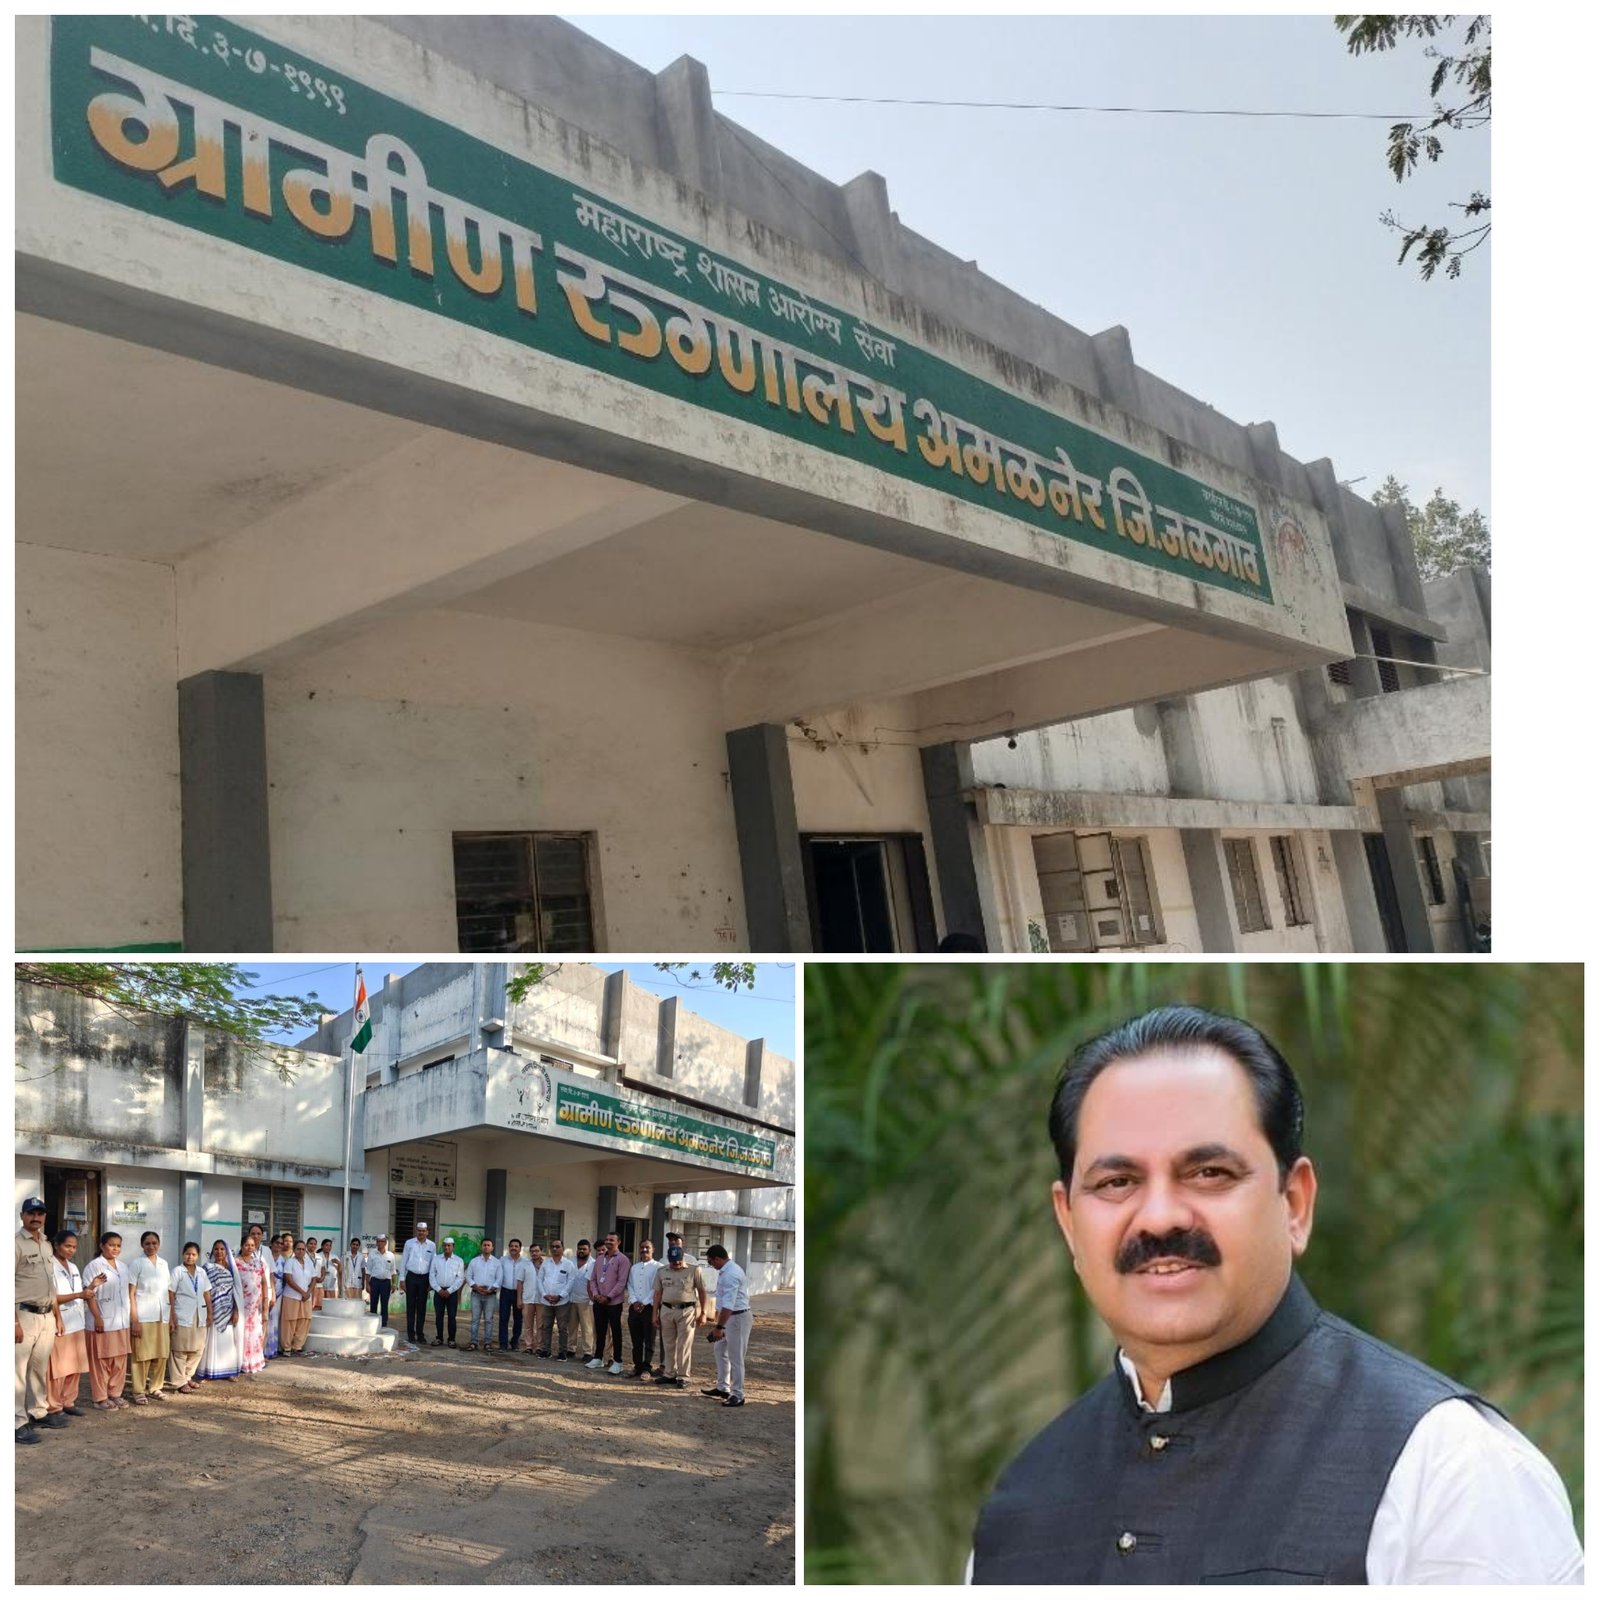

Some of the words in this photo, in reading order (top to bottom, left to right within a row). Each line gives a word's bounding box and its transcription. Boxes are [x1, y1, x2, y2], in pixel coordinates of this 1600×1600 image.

[87, 46, 544, 316] ग्रामीण
[913, 397, 1105, 531] अमळनेर
[573, 193, 692, 284] महाराष्ट्र
[696, 252, 761, 308] शासन
[768, 286, 842, 346] आरोग्य
[853, 320, 897, 369] सेवा
[559, 1099, 615, 1130] ग्रामीण
